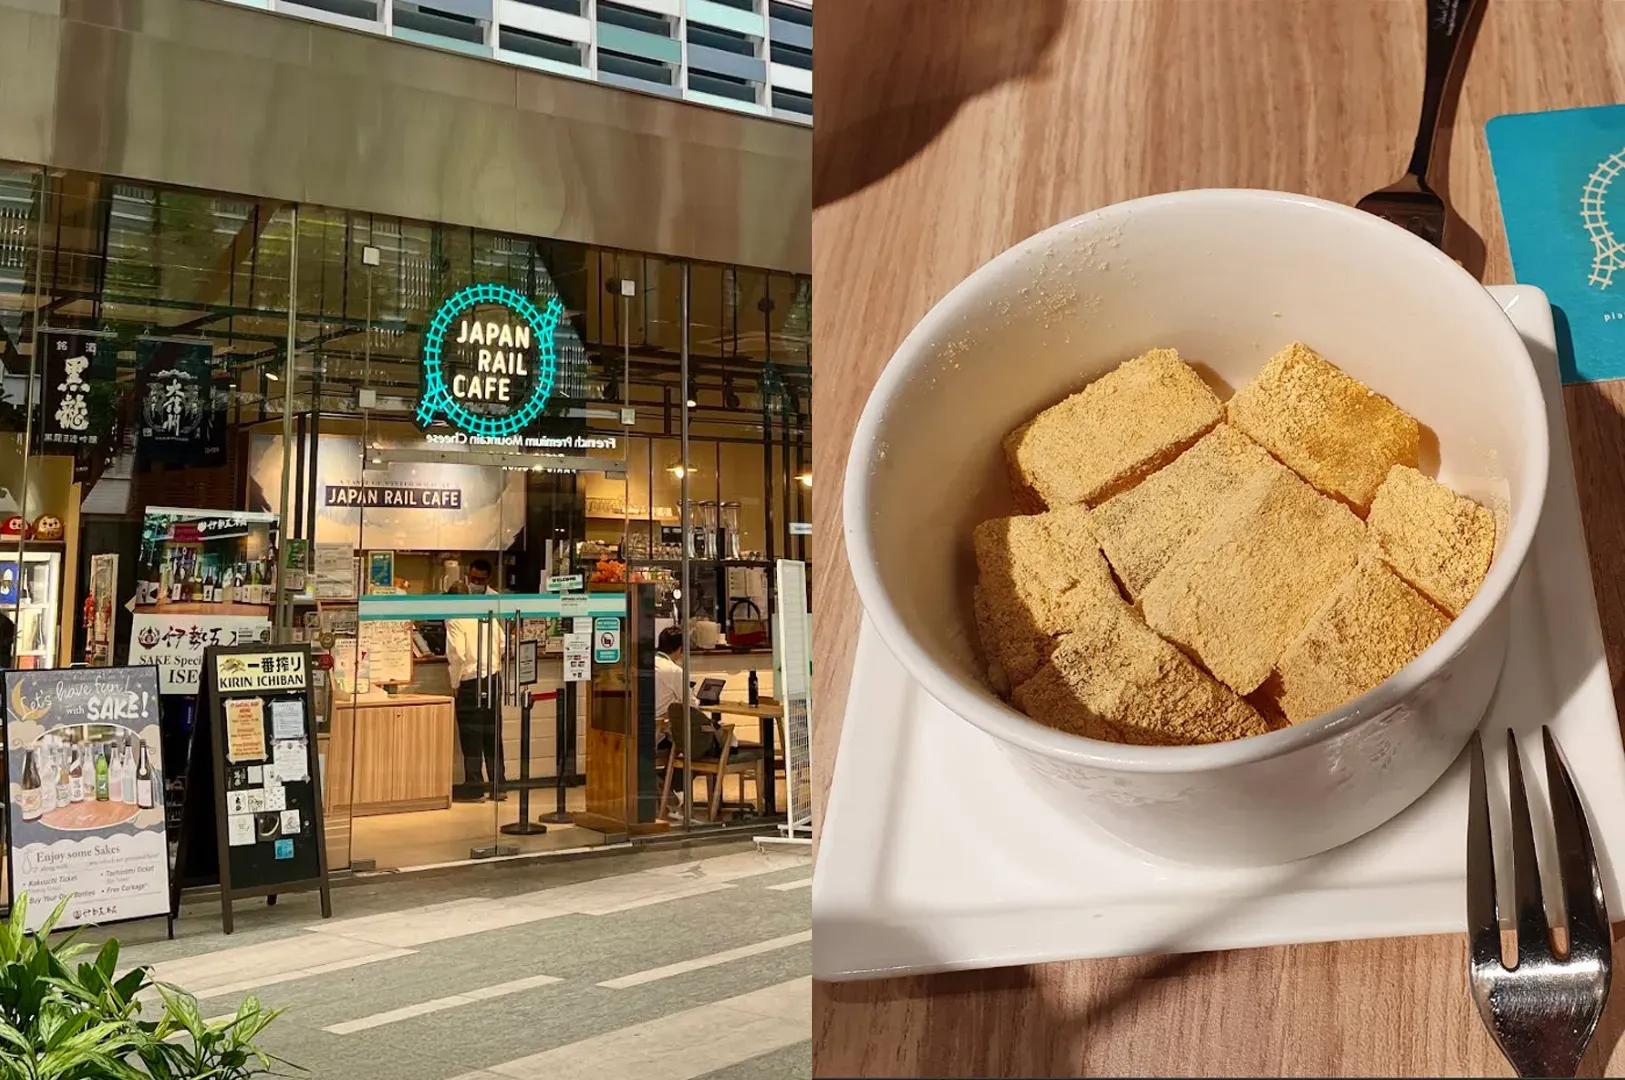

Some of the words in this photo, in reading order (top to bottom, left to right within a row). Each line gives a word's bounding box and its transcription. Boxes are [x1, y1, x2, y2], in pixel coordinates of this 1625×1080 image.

[1603, 312, 1625, 323] pla
[456, 320, 531, 349] JAPAN
[478, 349, 528, 376] RAIL
[453, 373, 511, 402] CAFE
[328, 488, 378, 504] JAPAN
[384, 490, 417, 505] RAIL
[422, 491, 459, 506] CAFE
[139, 656, 171, 665] SAKE
[174, 656, 202, 667] Speci
[247, 656, 301, 673] 一番搾り
[168, 669, 199, 684] ISE
[219, 677, 253, 688] KIRIN
[257, 675, 304, 687] ICHIBAN
[56, 680, 92, 702] have
[66, 705, 85, 715] with
[36, 852, 66, 864] Enjoy
[67, 848, 92, 858] some
[94, 845, 120, 856] Sakes
